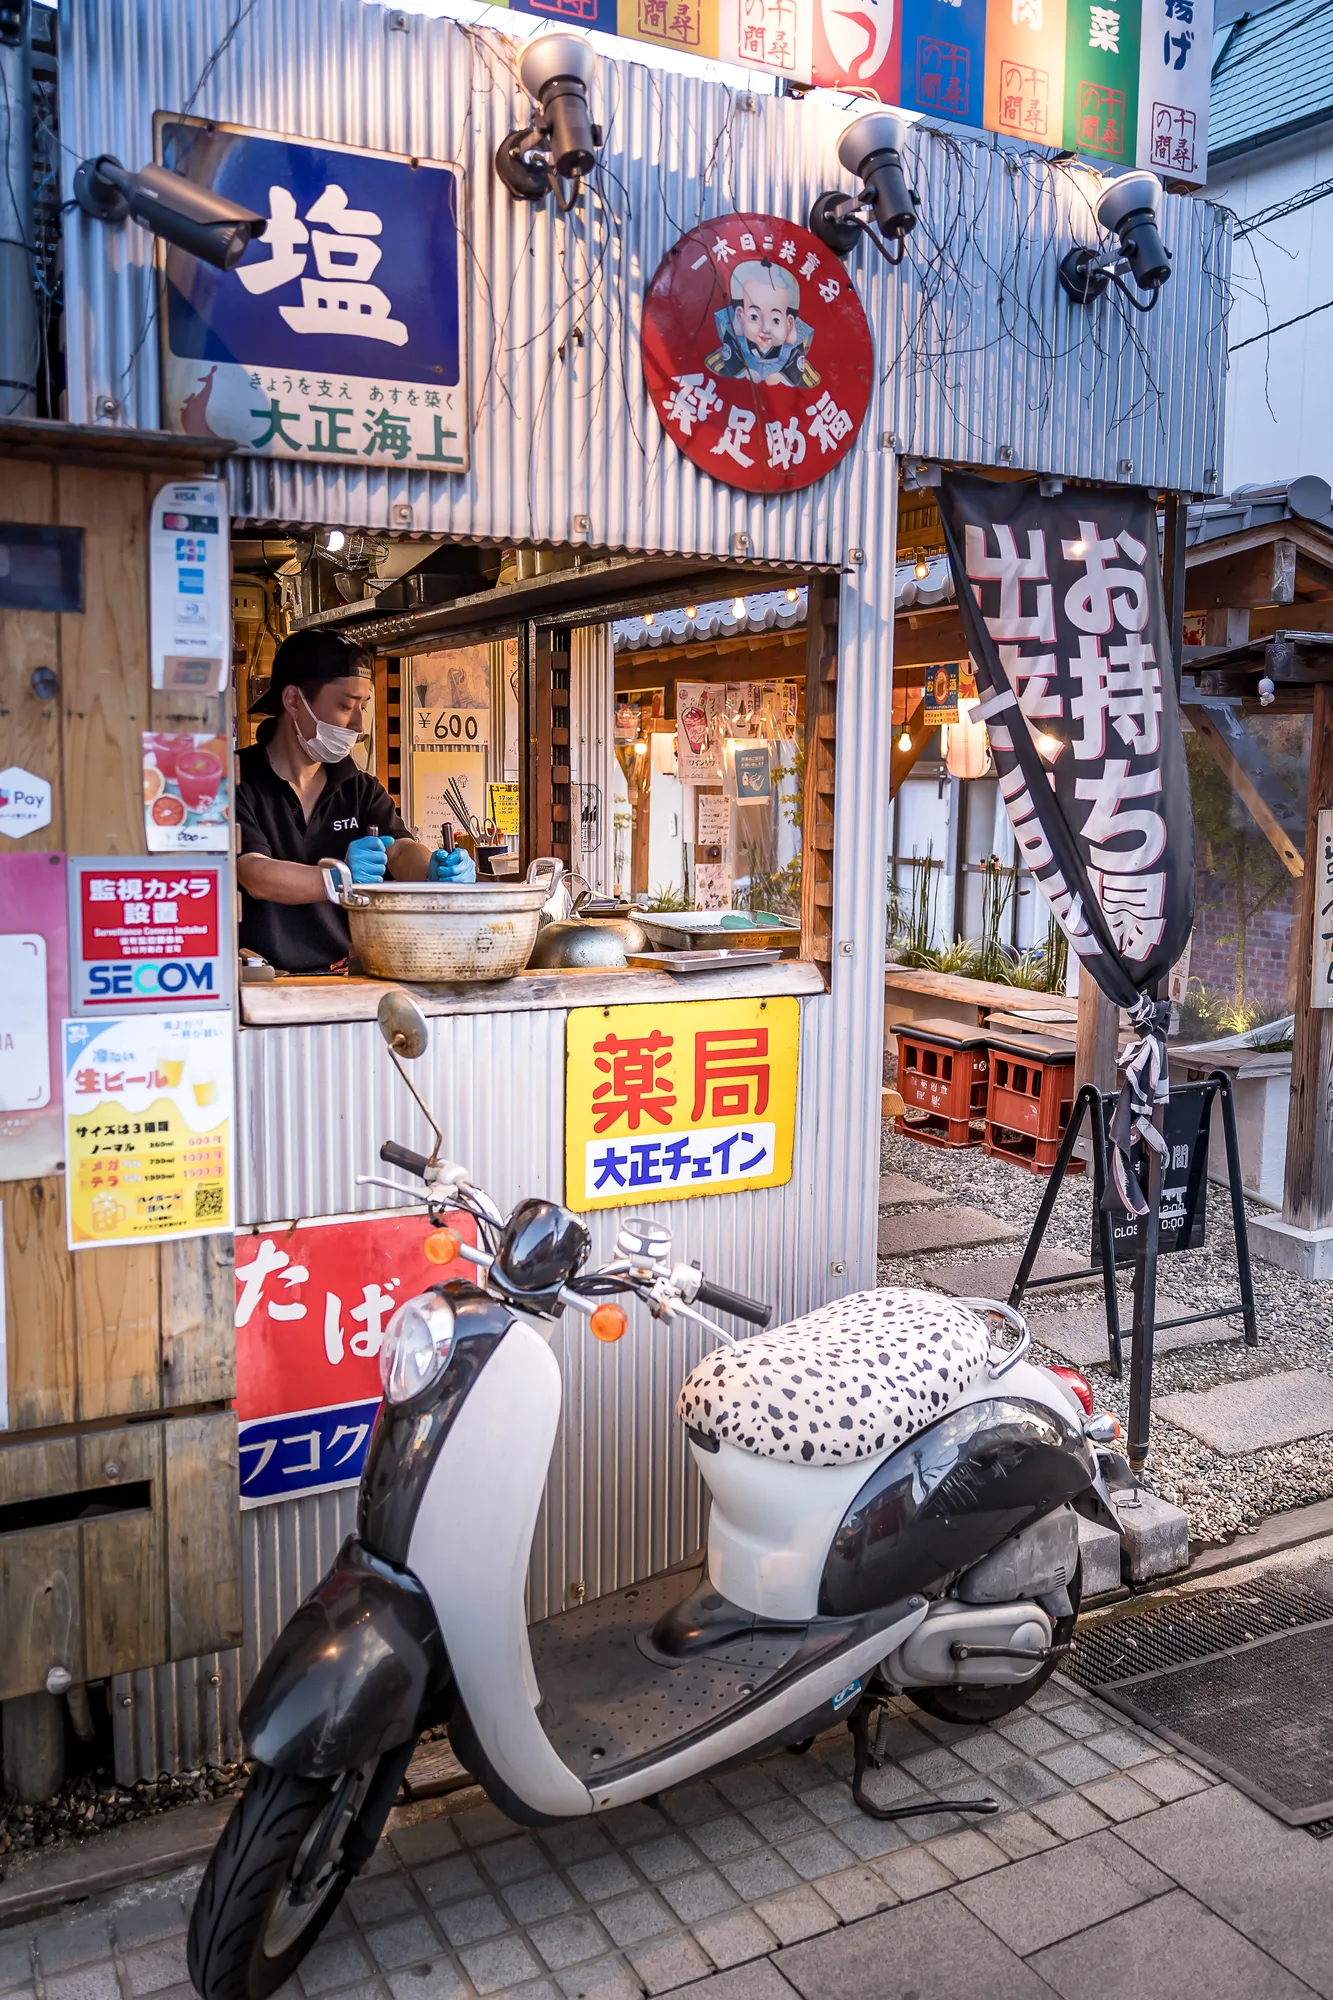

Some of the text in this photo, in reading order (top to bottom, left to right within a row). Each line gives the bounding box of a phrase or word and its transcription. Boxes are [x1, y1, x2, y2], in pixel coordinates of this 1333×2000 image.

[1088, 0, 1121, 54] 菜
[235, 184, 409, 347] 塩
[249, 372, 454, 411] きょうを支え あすを築く
[250, 398, 464, 465] 大正海上
[418, 711, 478, 740] ¥600
[333, 816, 359, 831] STA
[89, 878, 212, 901] 監視カメラ
[123, 901, 179, 925] 設置
[89, 962, 213, 995] SECOM
[75, 1068, 169, 1094] 生ビール
[592, 1028, 770, 1134] 薬局
[91, 1143, 136, 1155] ノーマル
[593, 1131, 768, 1190] 大正チェイン
[1114, 1225, 1138, 1239] CLOS
[235, 1239, 401, 1366] たば
